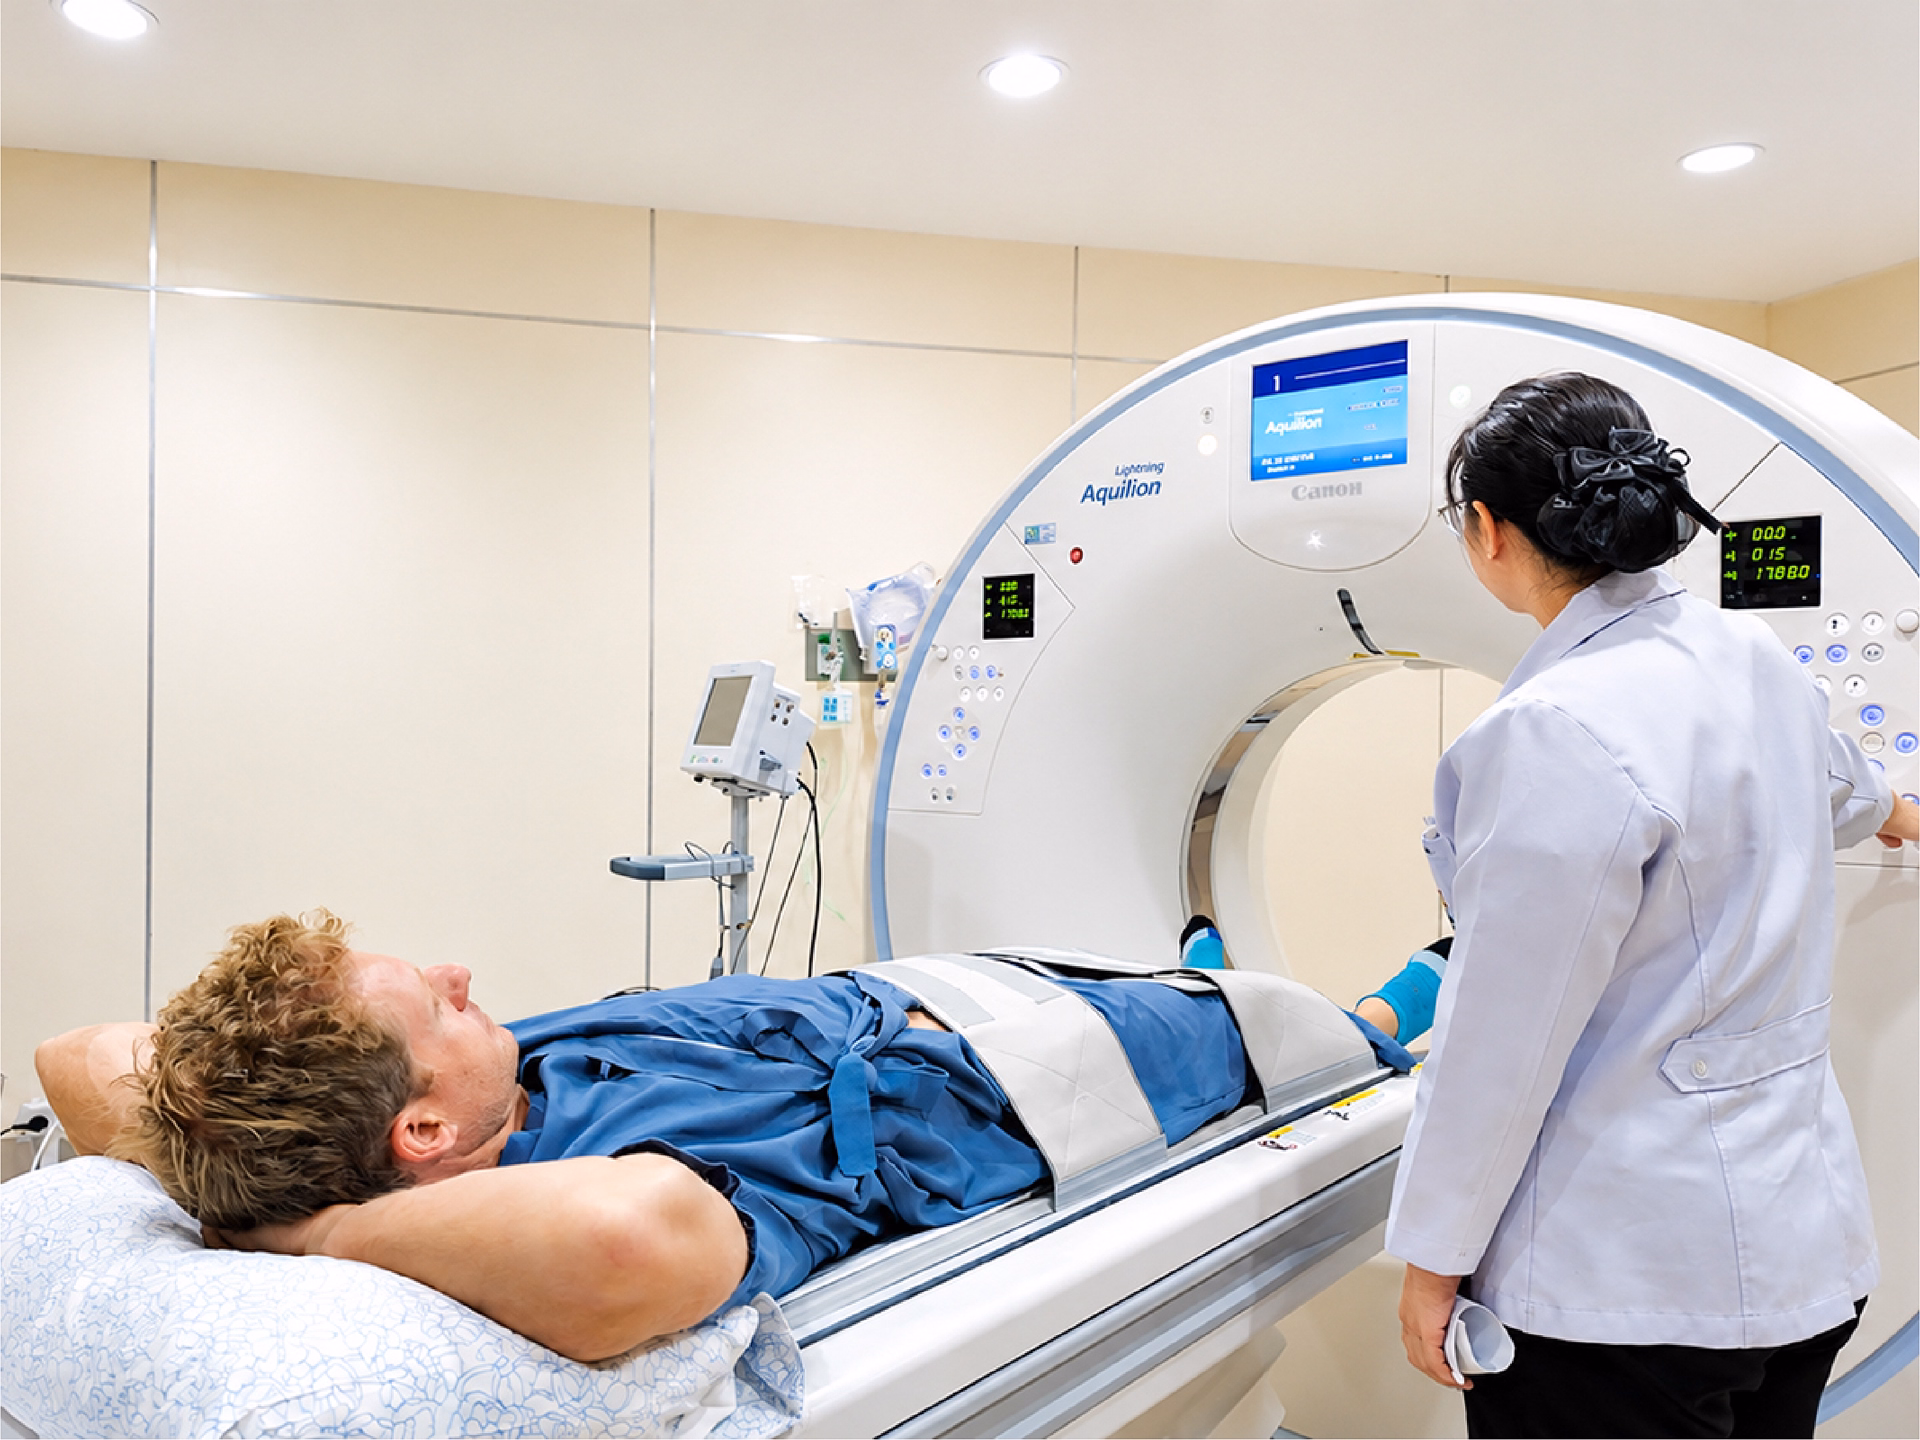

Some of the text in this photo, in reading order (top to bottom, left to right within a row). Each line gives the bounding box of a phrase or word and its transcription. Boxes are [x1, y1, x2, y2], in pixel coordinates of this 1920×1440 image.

[1273, 375, 1280, 391] 1
[1115, 462, 1164, 477] Lightning
[1081, 479, 1162, 506] Aquilion
